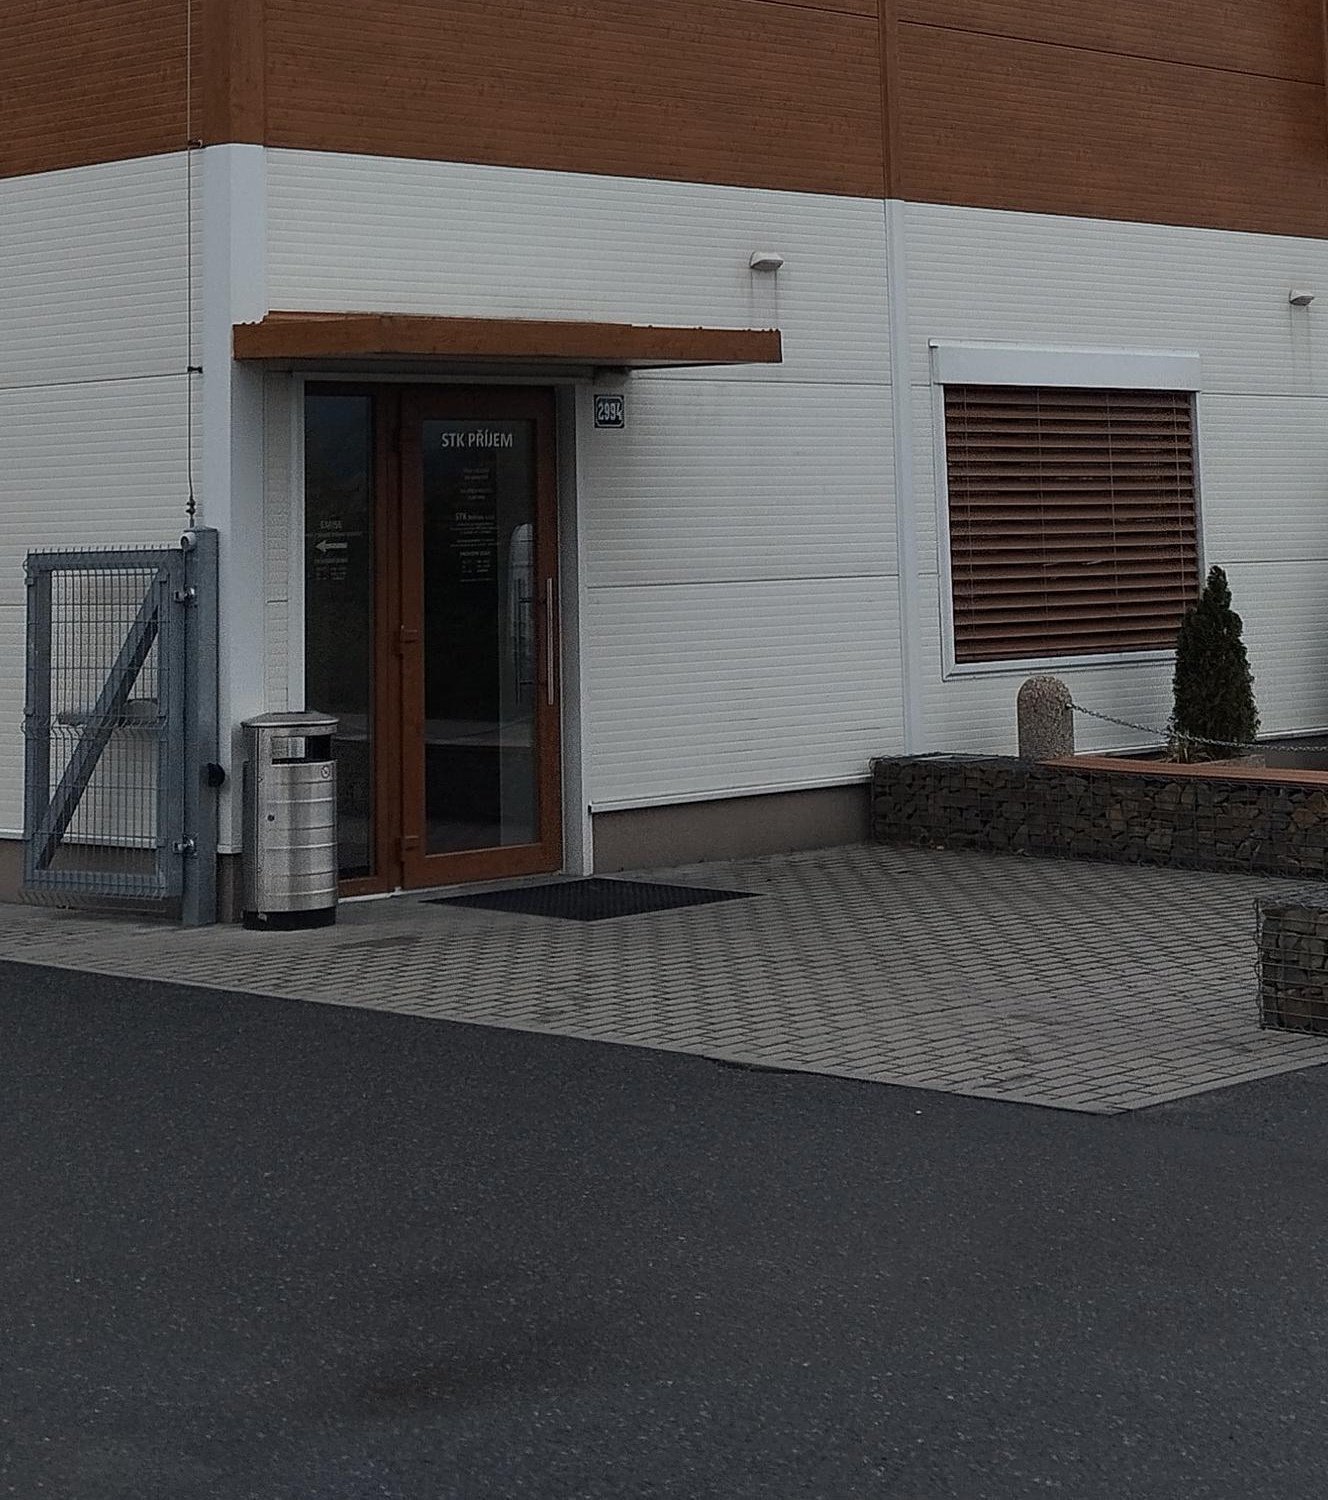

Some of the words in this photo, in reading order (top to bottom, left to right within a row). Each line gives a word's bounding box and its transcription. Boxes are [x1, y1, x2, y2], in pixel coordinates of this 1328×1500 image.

[598, 402, 623, 421] 2994
[441, 432, 465, 448] STK
[467, 428, 513, 448] PŘÍJEM
